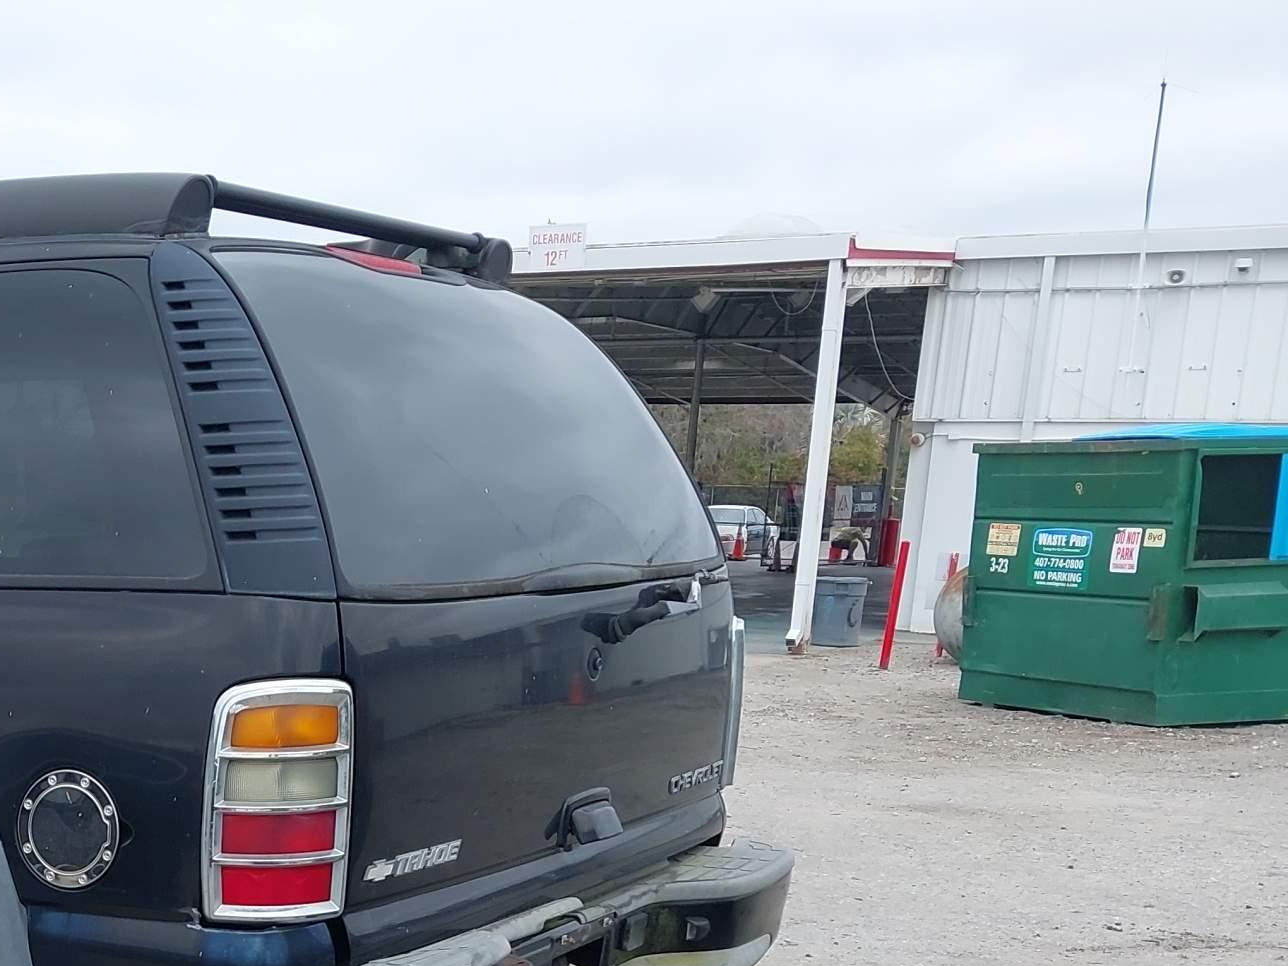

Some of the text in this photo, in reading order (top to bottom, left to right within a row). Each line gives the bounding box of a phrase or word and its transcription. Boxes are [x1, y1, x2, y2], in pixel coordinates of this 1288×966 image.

[532, 231, 583, 245] CLEARANCE
[544, 249, 569, 267] 12 FT
[1038, 533, 1088, 548] WASTE PRO
[1116, 531, 1141, 545] DO NOT
[1115, 547, 1135, 561] PARK
[990, 557, 1009, 574] 3-23
[1034, 557, 1084, 570] 407-774-0800
[1033, 570, 1082, 583] NO PARKING
[670, 759, 724, 794] CHEVROLET
[393, 838, 463, 877] TAHOE
